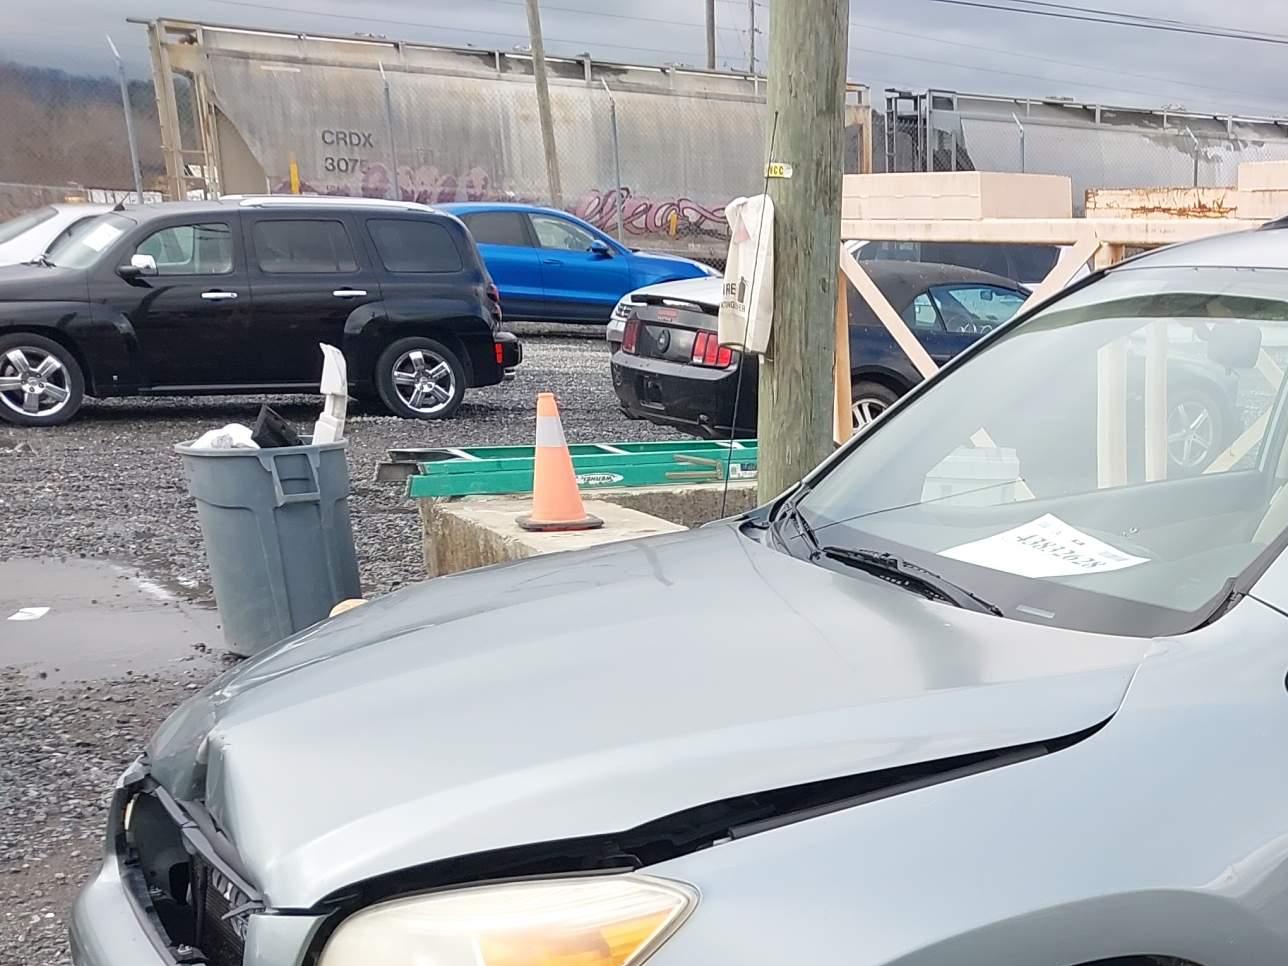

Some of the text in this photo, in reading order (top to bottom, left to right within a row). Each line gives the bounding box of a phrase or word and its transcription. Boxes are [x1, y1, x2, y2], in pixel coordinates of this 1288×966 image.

[321, 130, 374, 148] CRDX
[722, 282, 737, 296] IRE
[1016, 533, 1107, 568] 43832628
